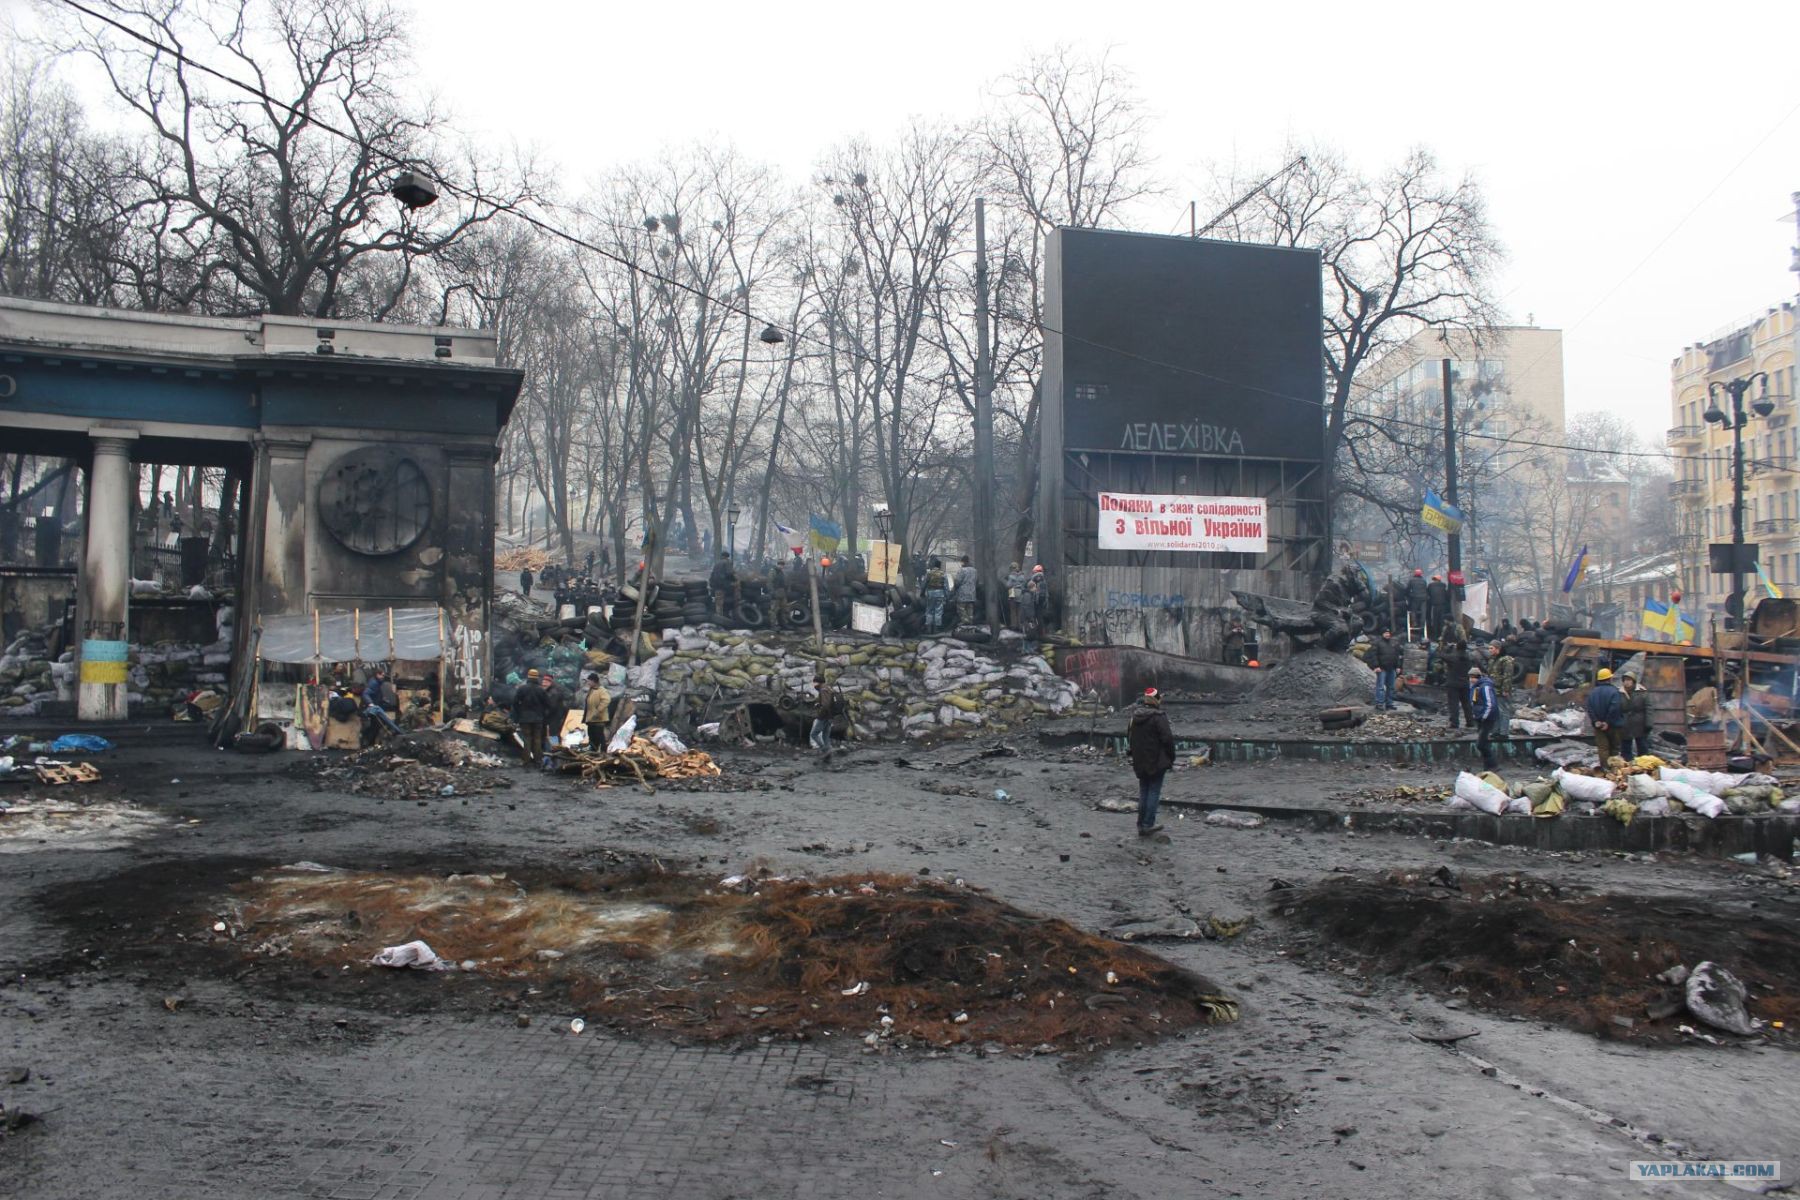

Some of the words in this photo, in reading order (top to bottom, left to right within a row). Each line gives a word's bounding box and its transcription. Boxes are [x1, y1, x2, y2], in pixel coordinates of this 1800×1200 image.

[1101, 494, 1153, 513] Поляки
[1160, 503, 1166, 514] в
[1170, 503, 1194, 514] знак
[1197, 502, 1262, 516] солідарності
[1135, 517, 1193, 536] вільної
[1203, 518, 1262, 540] України
